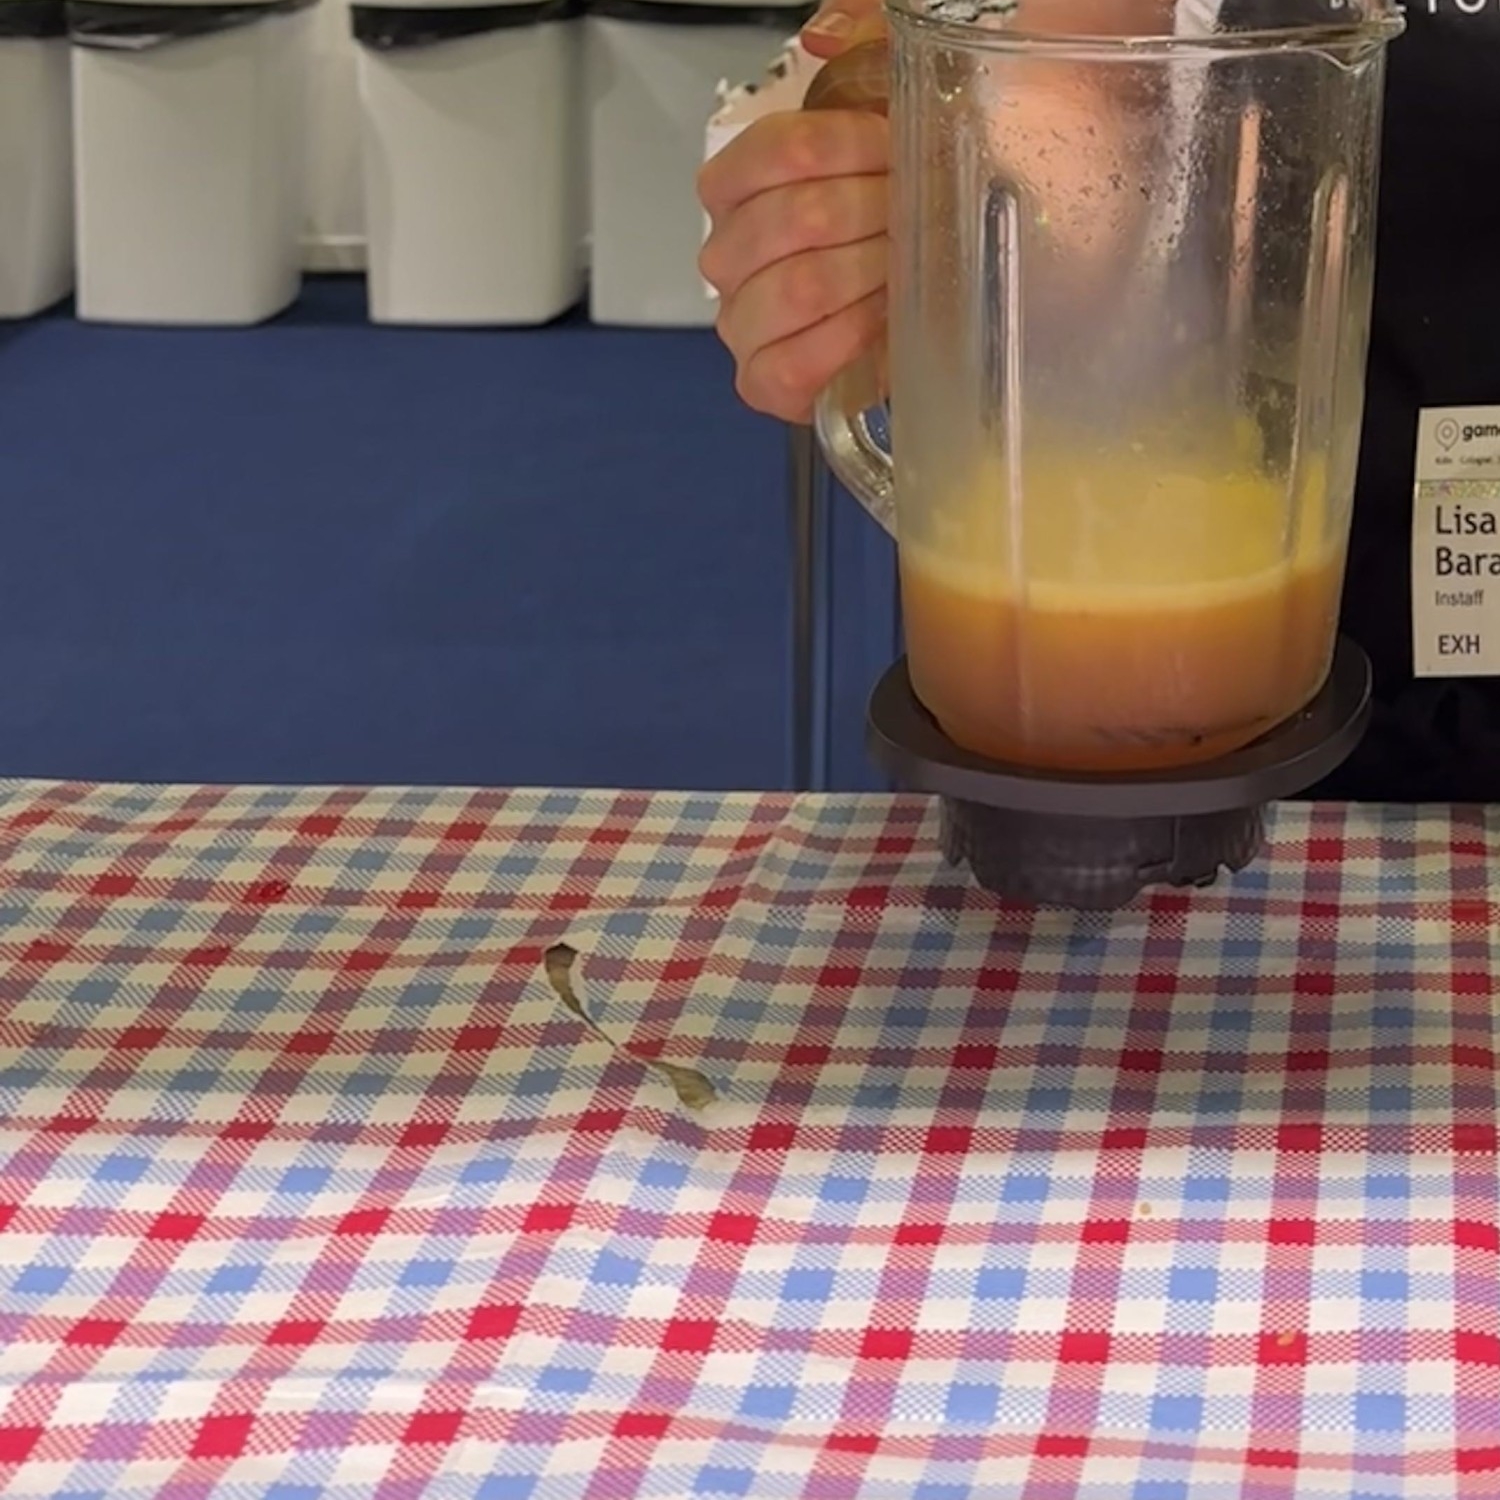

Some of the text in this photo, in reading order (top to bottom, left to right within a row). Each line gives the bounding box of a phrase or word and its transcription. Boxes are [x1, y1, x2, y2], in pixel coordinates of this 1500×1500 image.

[1435, 504, 1498, 535] Lisa
[1435, 589, 1484, 607] Instaff
[1438, 634, 1480, 655] EXH
